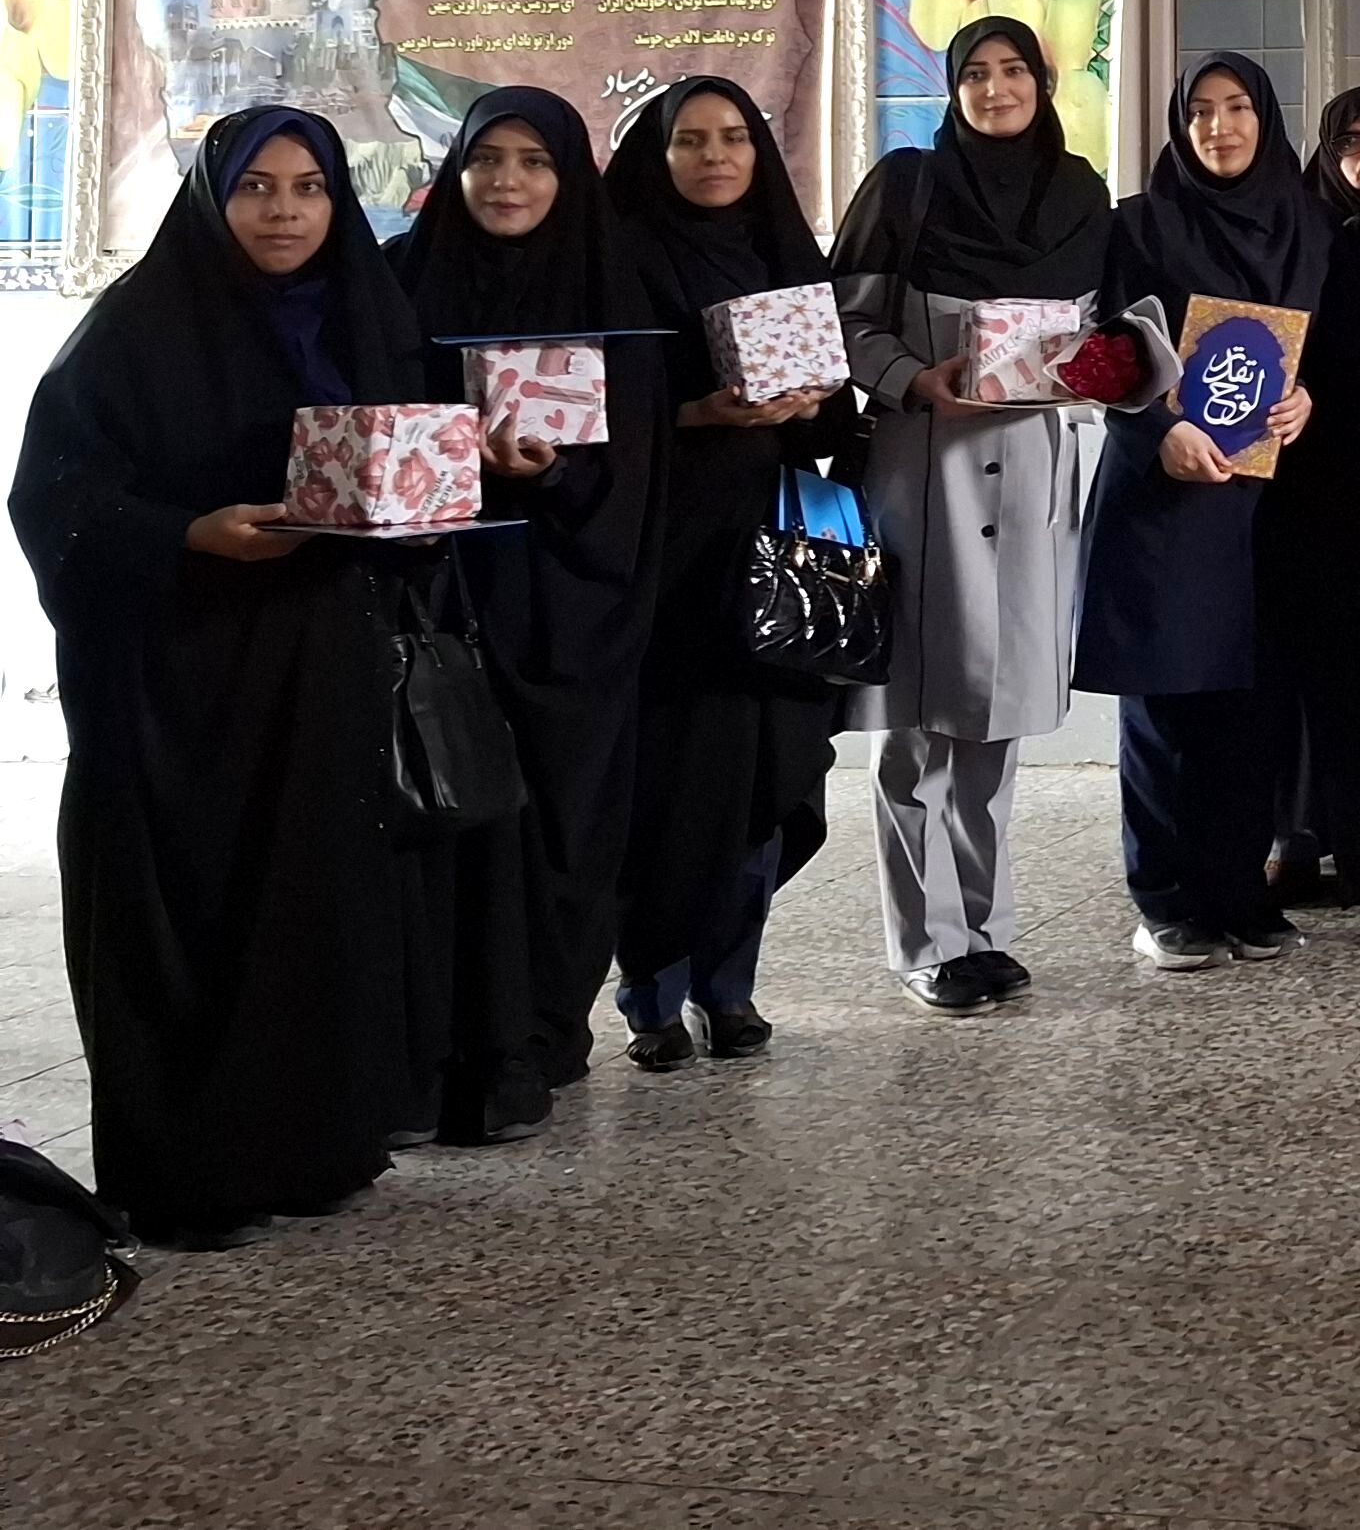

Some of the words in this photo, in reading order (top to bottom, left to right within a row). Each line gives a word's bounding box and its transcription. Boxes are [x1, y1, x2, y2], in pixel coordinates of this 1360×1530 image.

[431, 36, 458, 49] دست
[501, 32, 518, 52] ای
[532, 32, 545, 51] تو
[543, 32, 556, 52] از
[554, 32, 575, 51] دور
[735, 30, 752, 48] در
[751, 28, 765, 43] که
[764, 28, 777, 47] تو
